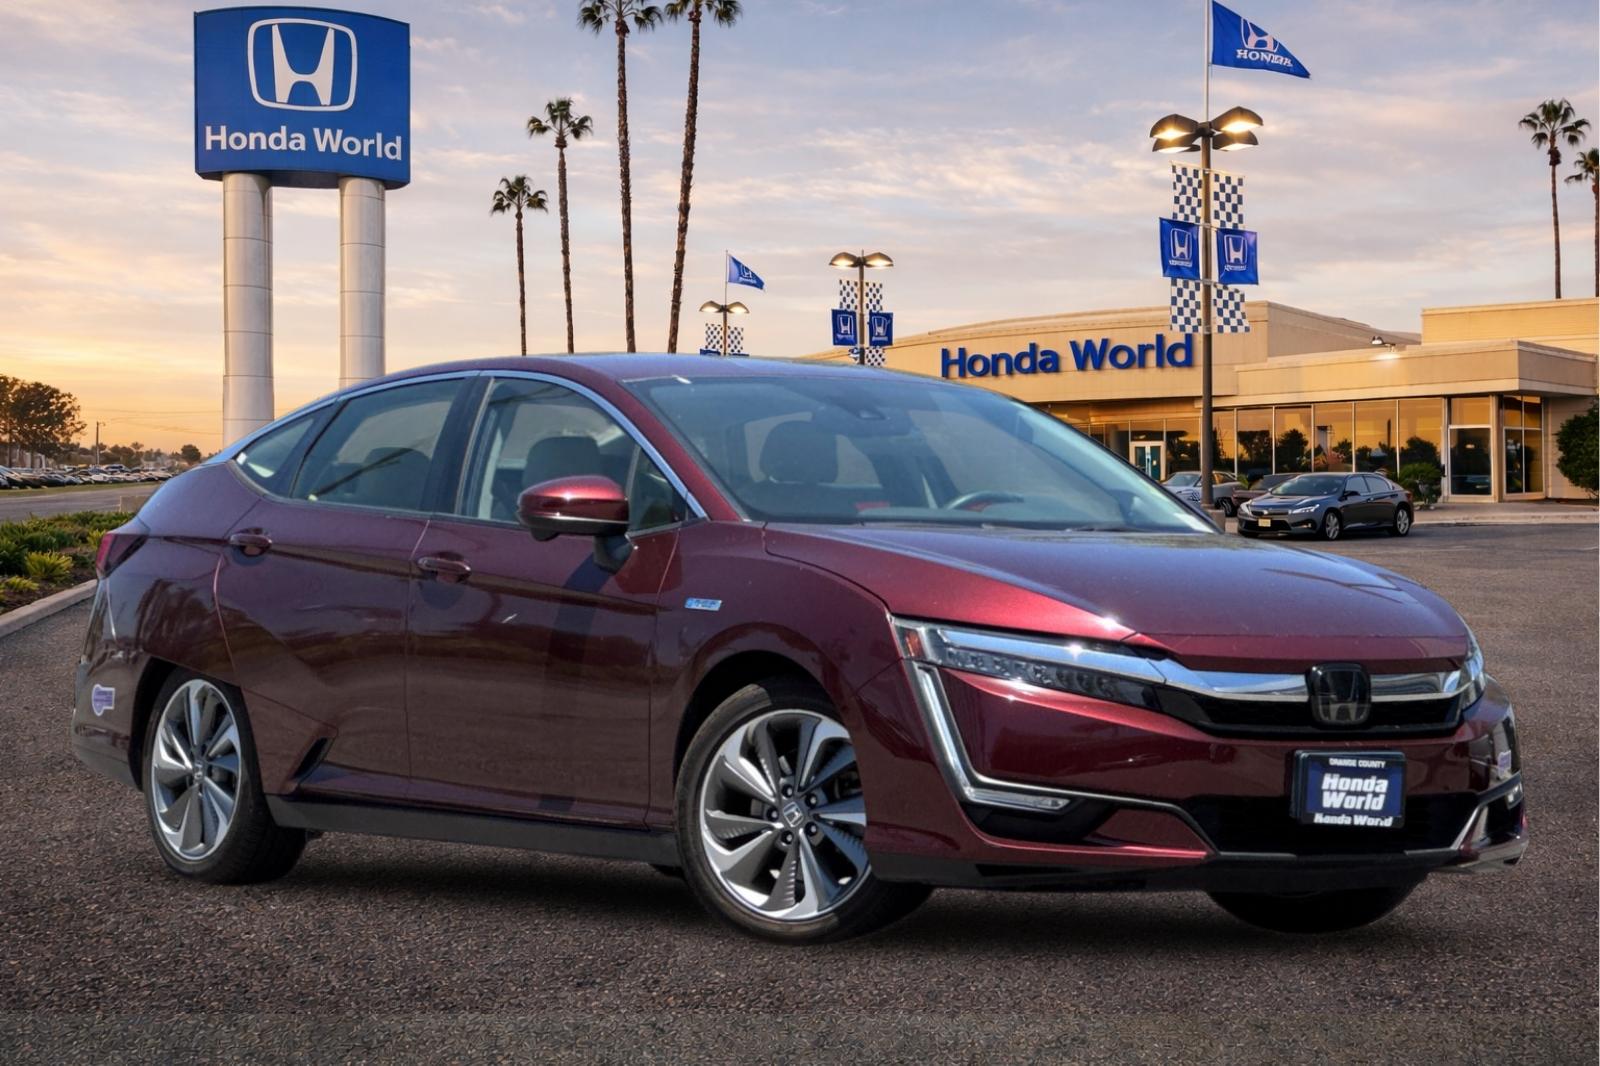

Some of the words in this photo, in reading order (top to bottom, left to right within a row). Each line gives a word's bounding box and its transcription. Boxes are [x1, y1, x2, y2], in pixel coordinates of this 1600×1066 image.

[205, 125, 306, 151] Honda
[313, 127, 402, 161] World
[940, 342, 1060, 379] Honda
[1069, 333, 1194, 371] World
[1358, 759, 1386, 769] COUNTY
[1321, 773, 1389, 794] Honda
[1321, 790, 1386, 811] World
